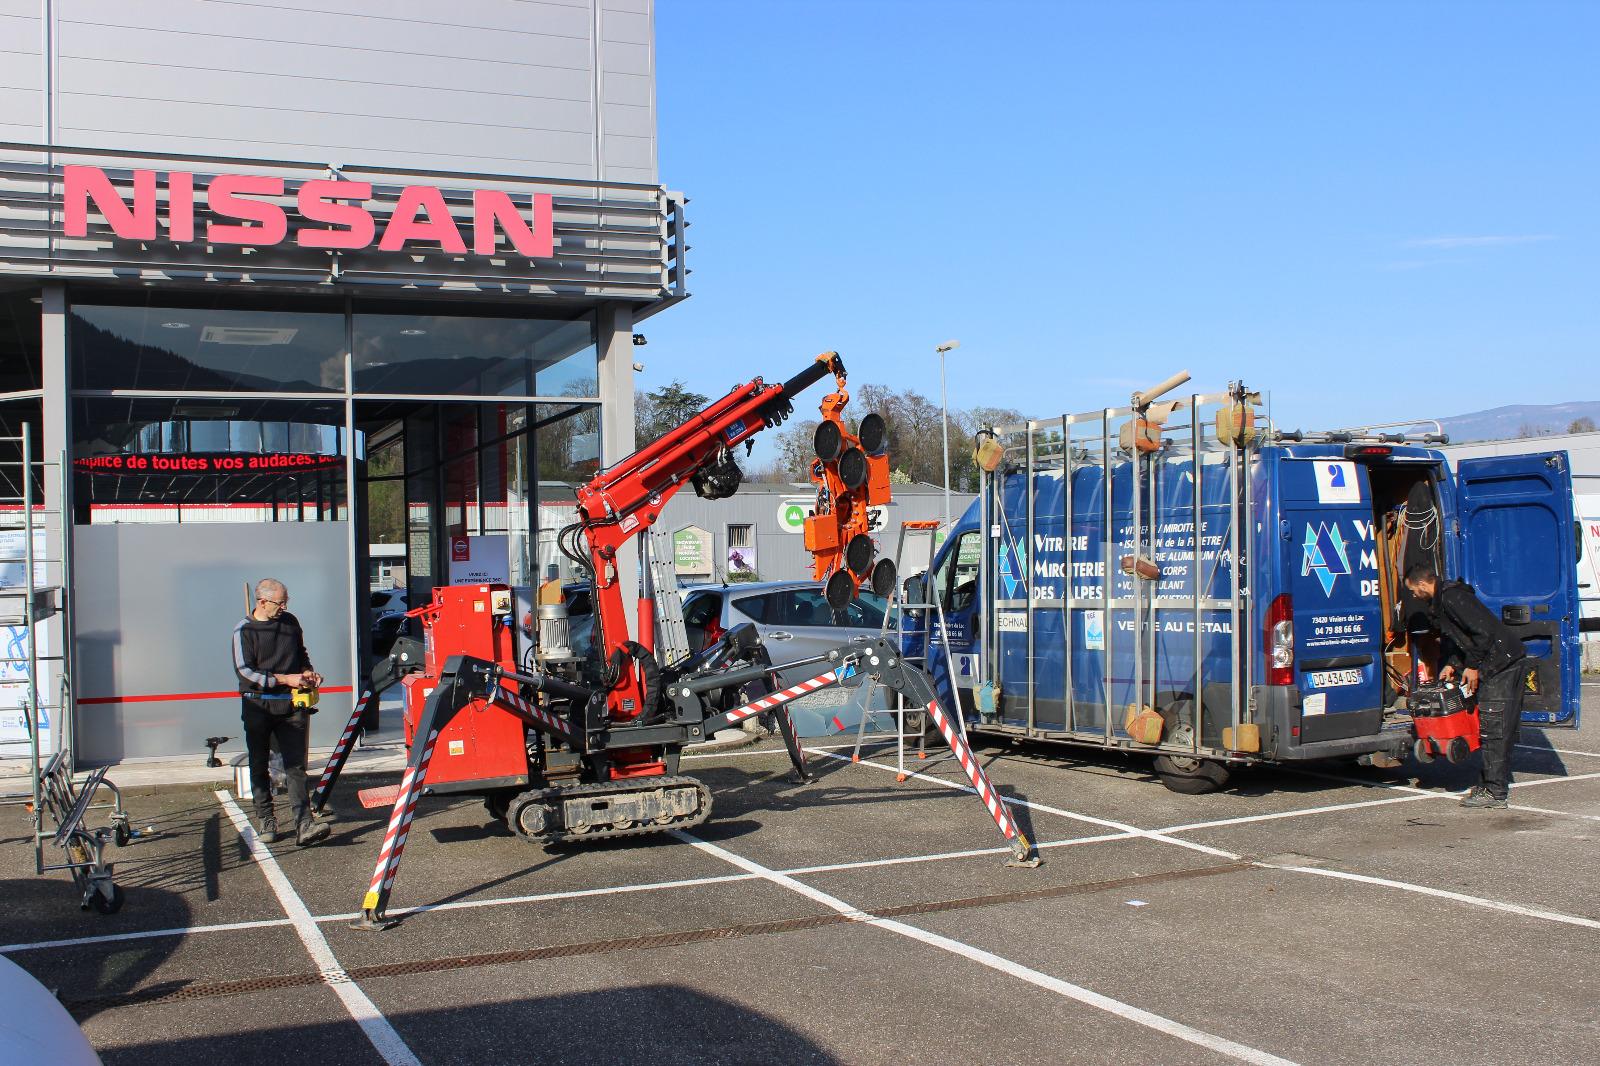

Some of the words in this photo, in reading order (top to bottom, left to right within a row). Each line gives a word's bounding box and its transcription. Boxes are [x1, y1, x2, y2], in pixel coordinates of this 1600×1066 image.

[64, 165, 554, 258] NISSAN
[126, 455, 148, 469] de
[152, 455, 208, 470] toutes
[213, 457, 244, 469] vos
[248, 453, 315, 468] audaces.
[1165, 537, 1175, 546] de
[1177, 536, 1185, 546] la
[1163, 566, 1187, 576] CORPS
[1033, 586, 1054, 600] DES
[1312, 616, 1327, 624] 73420
[1329, 615, 1346, 623] Viviers
[1164, 622, 1182, 632] AU
[1315, 627, 1324, 635] 04
[1325, 626, 1333, 634] 79
[1334, 626, 1342, 634] 88
